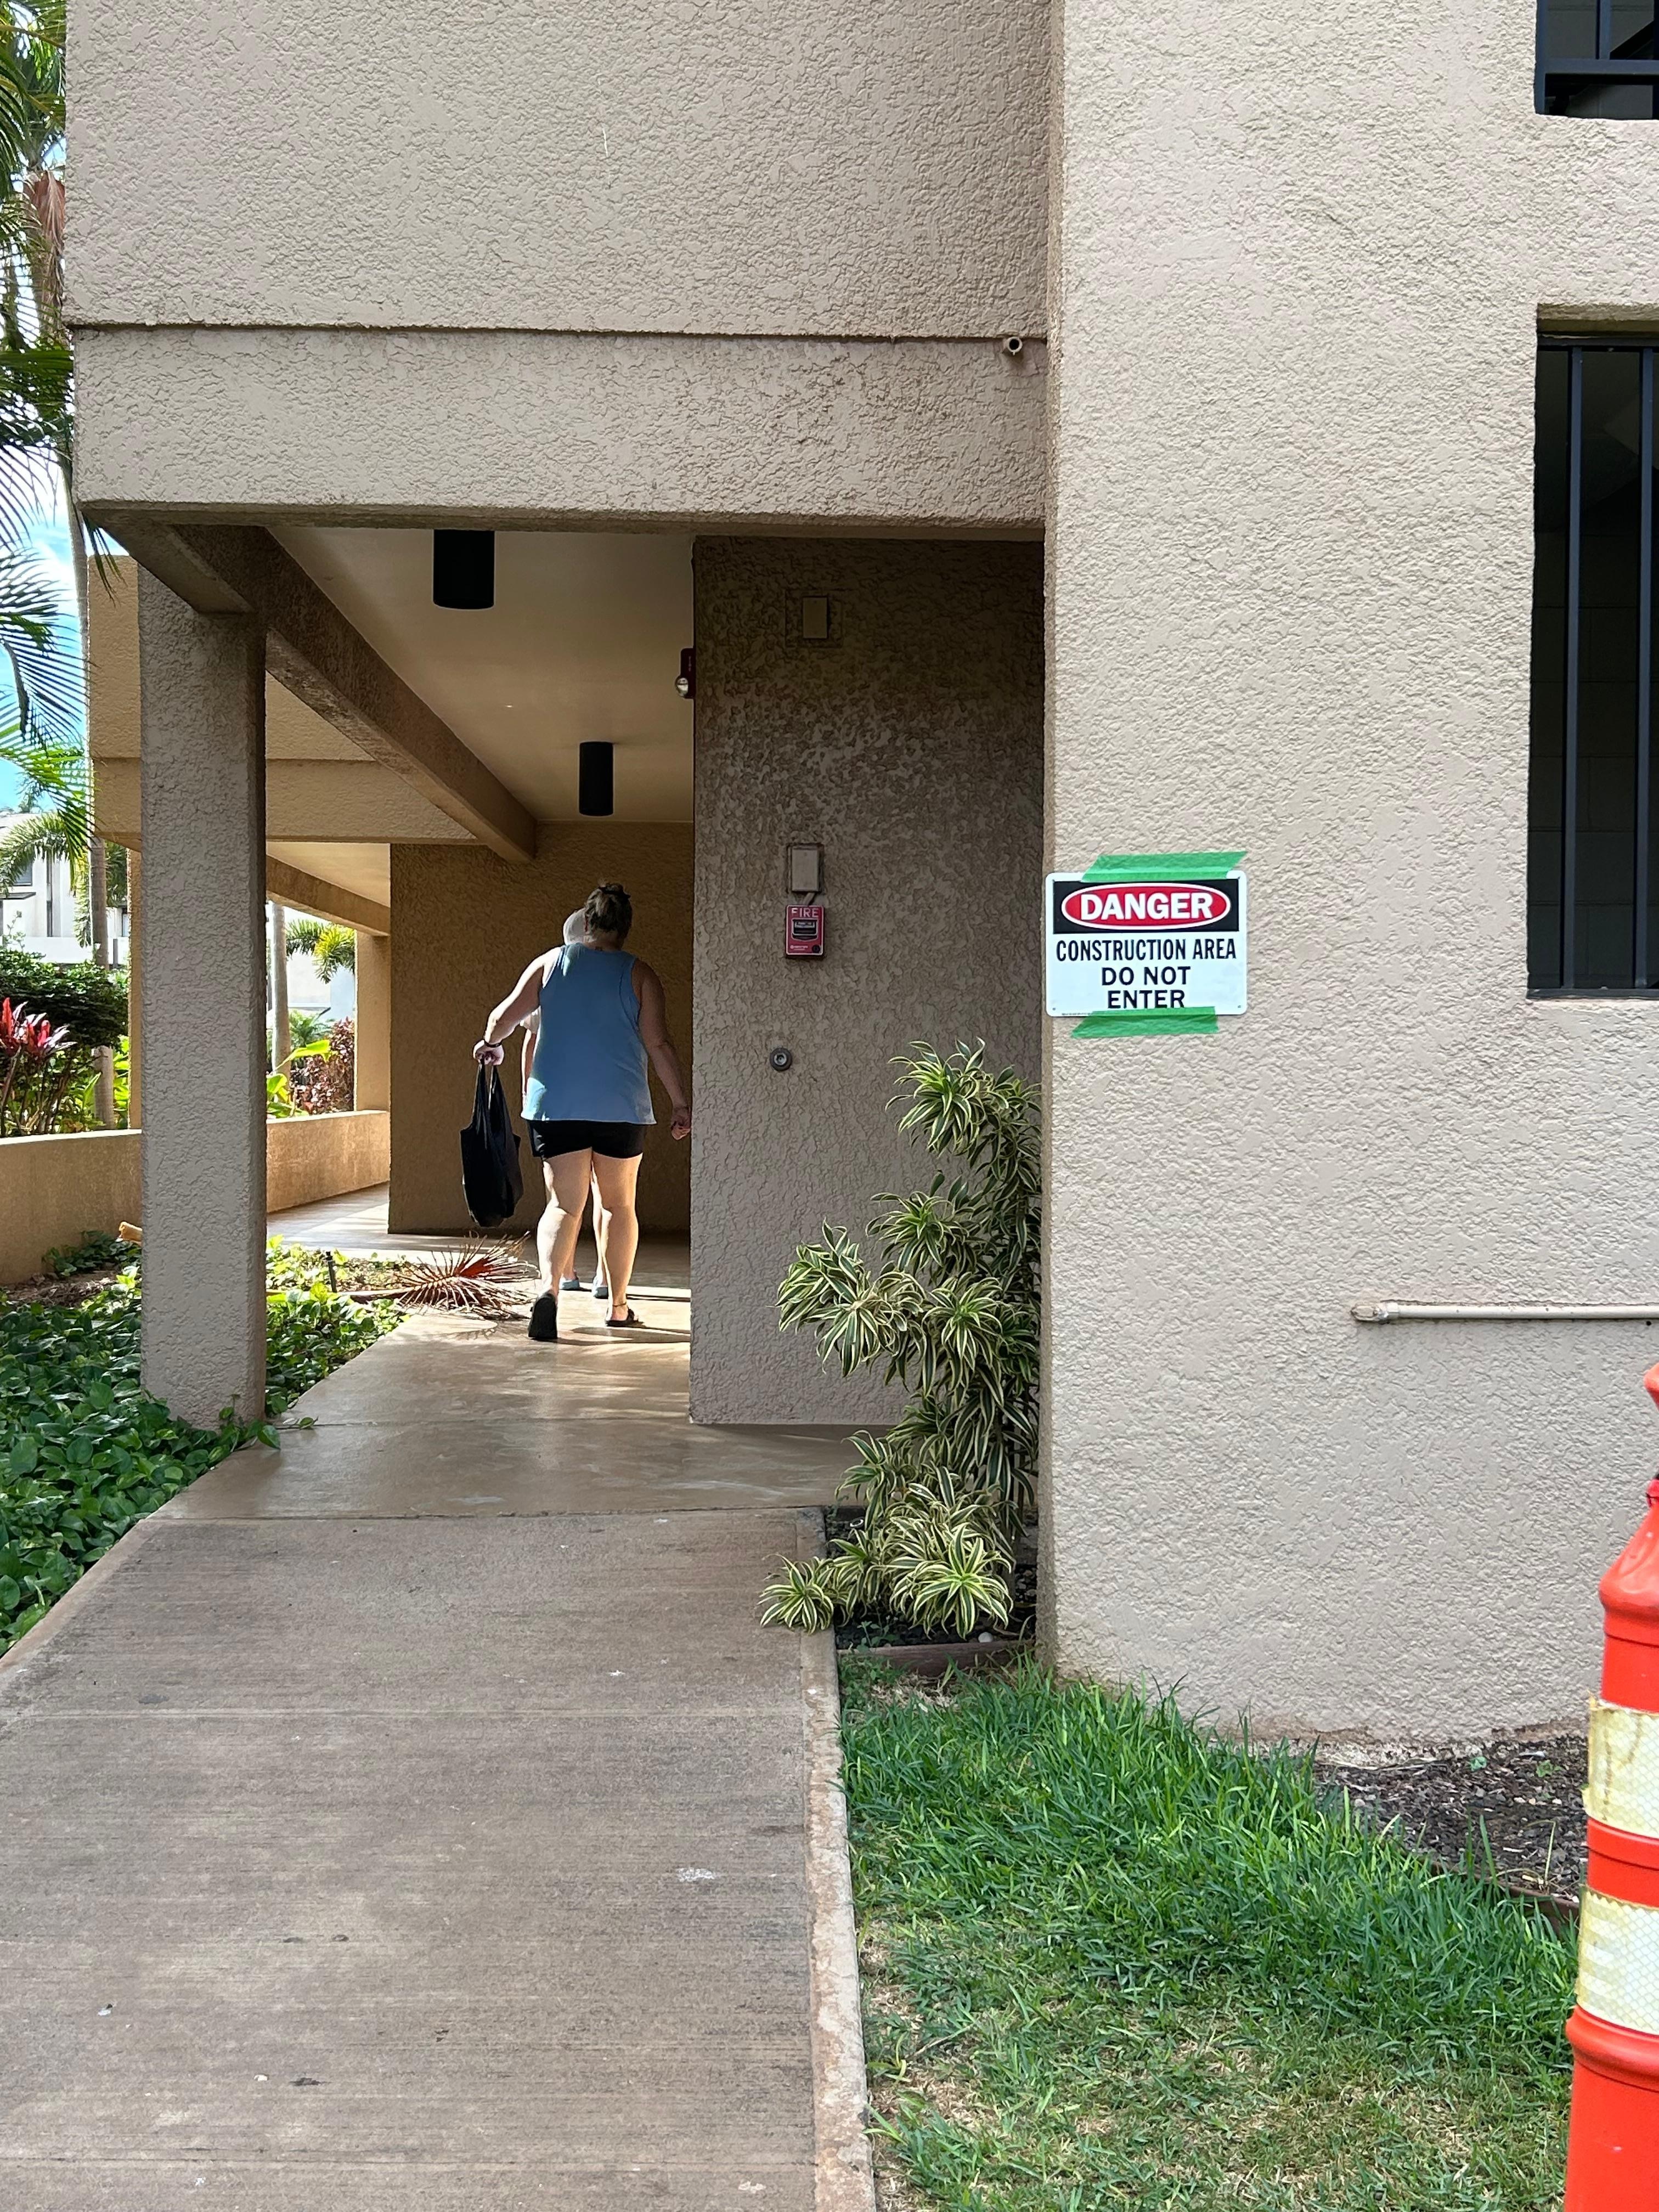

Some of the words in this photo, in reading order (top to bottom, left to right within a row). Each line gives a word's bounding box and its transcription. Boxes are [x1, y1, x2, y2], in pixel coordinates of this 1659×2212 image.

[791, 907, 819, 918] FIRE
[1081, 892, 1213, 920] DANGER
[1056, 939, 1186, 961] CONSTRUCTION
[1192, 938, 1237, 960] AREA
[1102, 967, 1135, 985] DO
[1144, 966, 1191, 985] NOT
[1107, 990, 1185, 1008] ENTER
